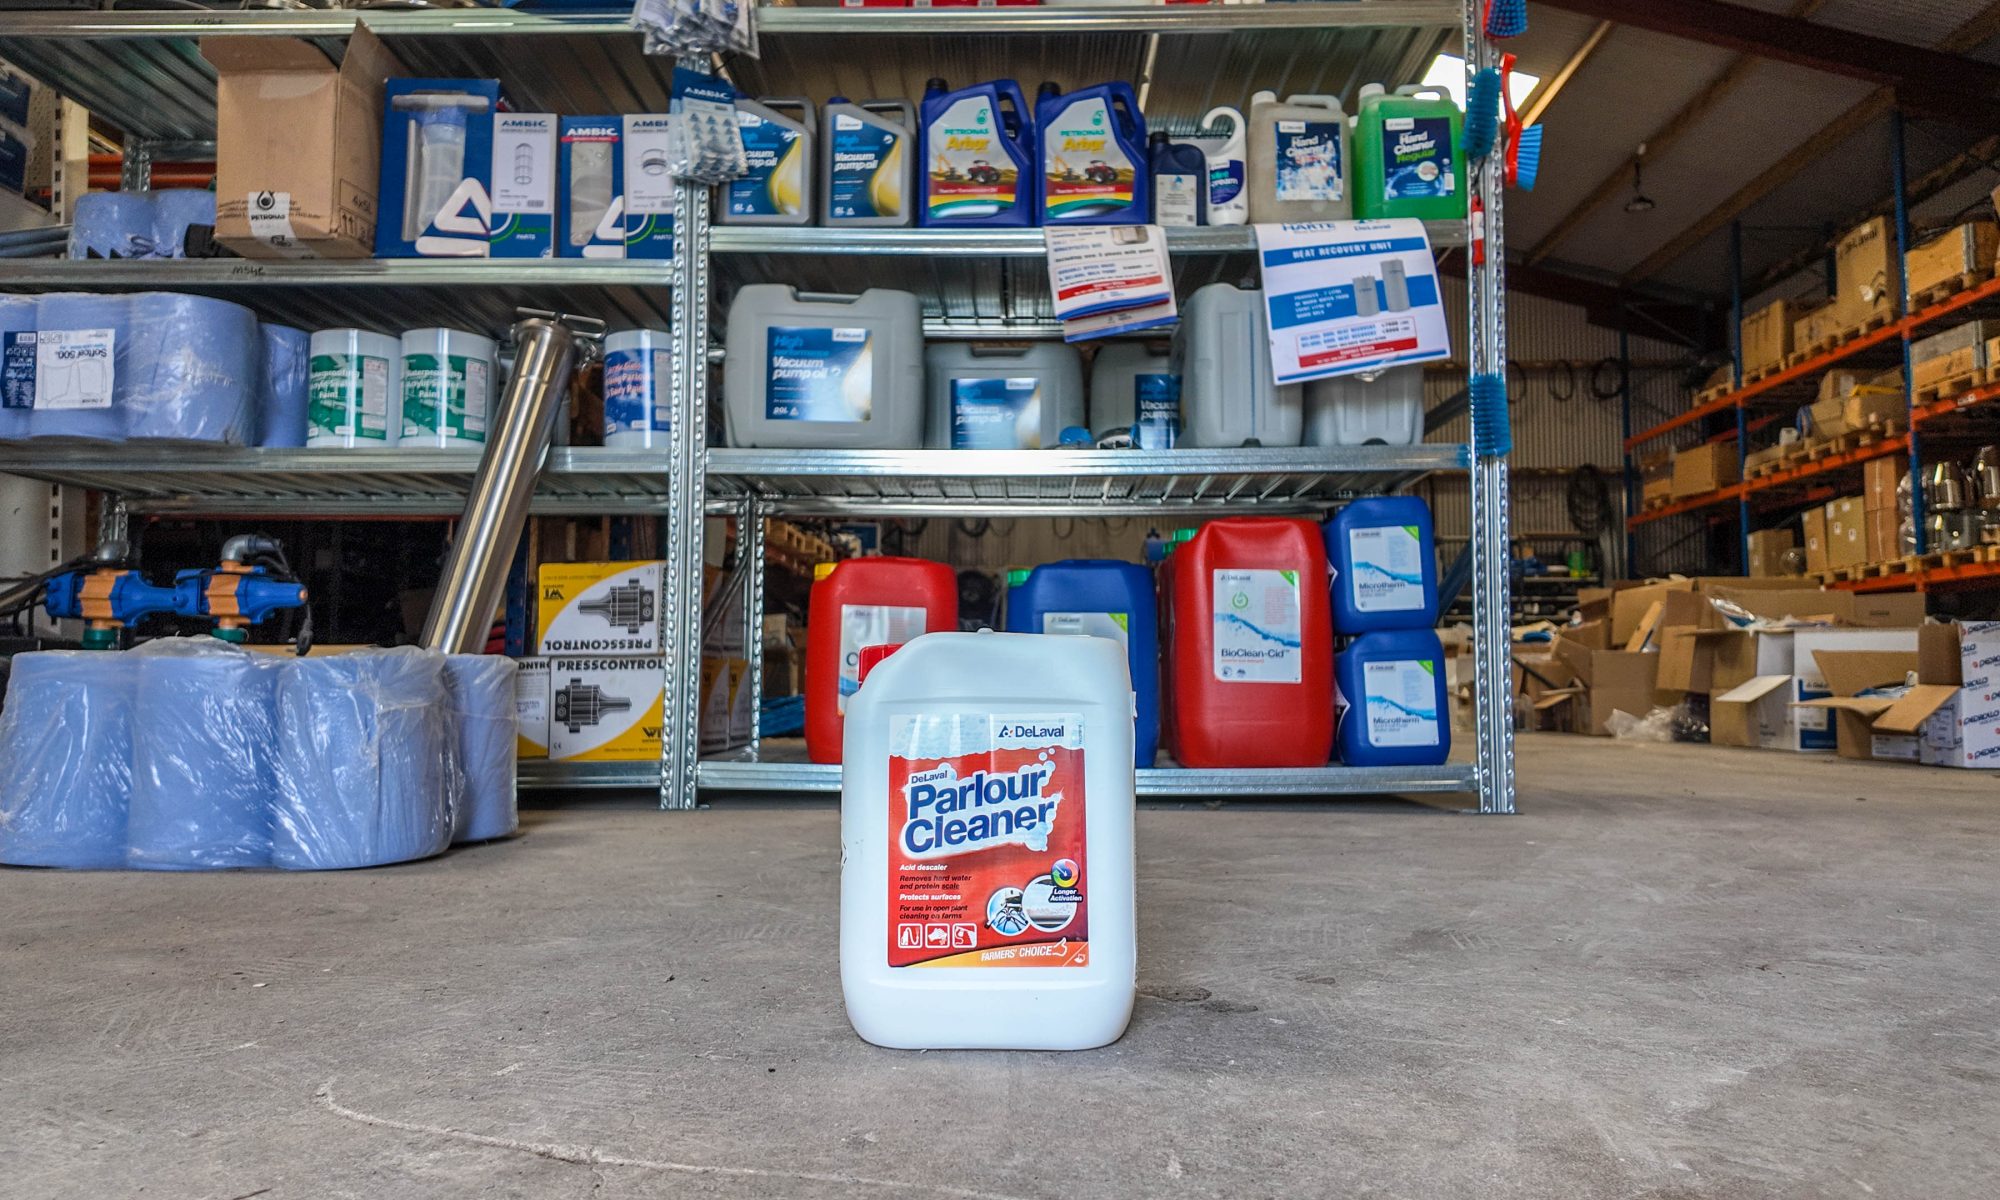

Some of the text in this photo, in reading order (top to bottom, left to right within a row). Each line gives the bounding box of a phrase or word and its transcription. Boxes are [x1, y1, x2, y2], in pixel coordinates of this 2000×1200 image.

[684, 86, 730, 100] AMBIC
[501, 120, 548, 128] AMBIC
[632, 120, 669, 128] AMBI
[566, 127, 618, 137] AMBIC
[944, 128, 990, 136] PETRONAS
[1060, 128, 1106, 136] PETRONAS
[1292, 136, 1319, 146] Hand
[1399, 131, 1428, 146] Hand
[1393, 139, 1436, 155] Cleaner
[834, 152, 875, 161] Vacuum
[1396, 149, 1436, 163] Regular
[834, 161, 866, 172] pump
[251, 213, 286, 221] PETRONAS
[1292, 241, 1393, 259] HEAT RECOVERY UNIT
[773, 357, 824, 367] Vacuum
[773, 368, 828, 380] pump oil
[956, 405, 1000, 415] Vacuum
[956, 415, 987, 425] pump
[1359, 581, 1406, 589] Microtherm
[545, 638, 653, 650] PRESSCONTROL
[557, 659, 665, 671] PRESSCONTROL
[1373, 716, 1420, 724] Microtherm
[1964, 709, 1999, 725] PEDROLLO
[1016, 725, 1064, 738] DeLaval
[911, 770, 947, 784] DeLaval
[909, 769, 1047, 820] Parlour
[905, 801, 1055, 853] Cleaner
[919, 863, 948, 871] descaler
[915, 883, 940, 891] protein
[900, 893, 961, 901] Protects surfaces
[951, 904, 968, 912] plant
[900, 912, 930, 920] cleaning
[981, 945, 1053, 961] FARMERS' CHOICE
